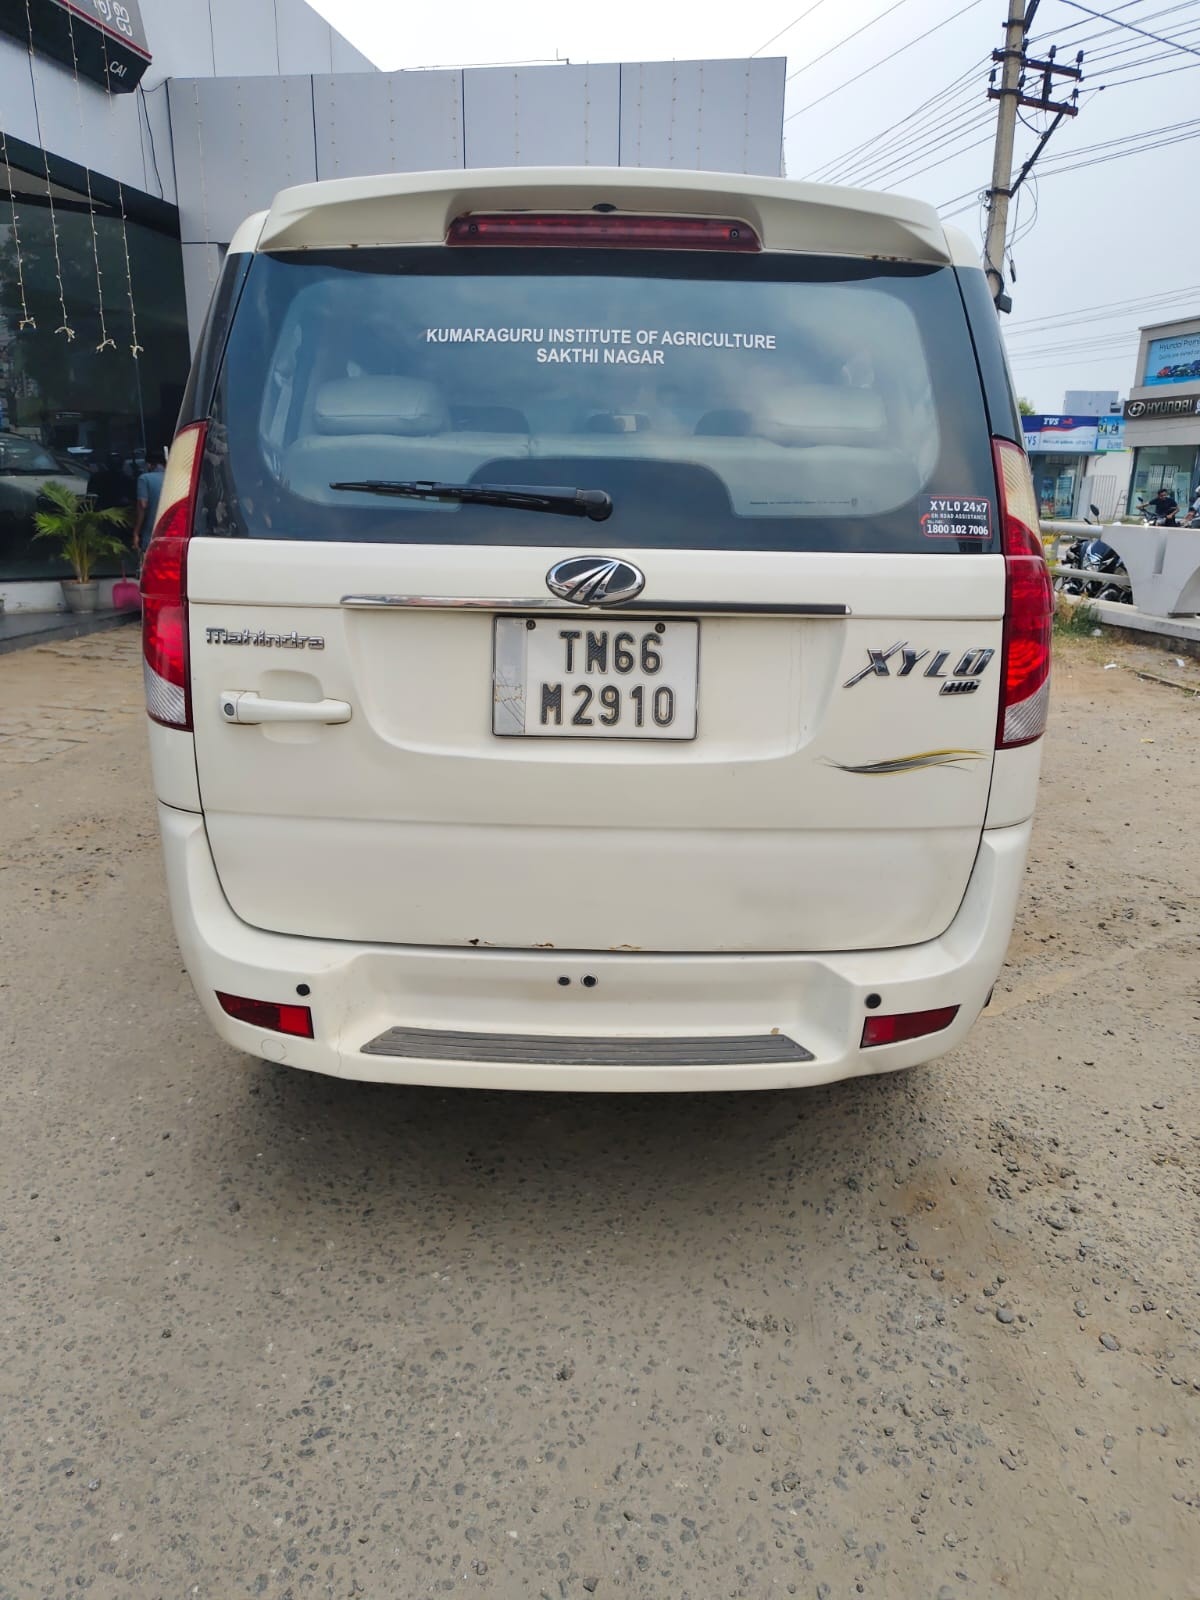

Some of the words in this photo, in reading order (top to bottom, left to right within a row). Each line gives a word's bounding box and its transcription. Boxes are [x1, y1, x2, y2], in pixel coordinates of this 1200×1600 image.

[109, 60, 128, 78] CAI
[426, 328, 544, 343] KUMARAGURU
[548, 328, 632, 344] INSTITUTE
[636, 330, 658, 345] OF
[661, 330, 777, 350] AGRICULTURE
[536, 348, 599, 364] SAKTHI
[603, 348, 665, 365] NAGAR
[1146, 399, 1193, 415] HYUNDAI
[1043, 417, 1060, 426] TVS
[930, 500, 961, 512] XYLO
[963, 501, 988, 513] 24x7
[926, 524, 949, 534] 1800
[951, 525, 967, 535] 102
[968, 525, 989, 536] 7006
[559, 630, 664, 674] TN66
[843, 640, 996, 689] XYLO
[540, 683, 676, 728] M2910
